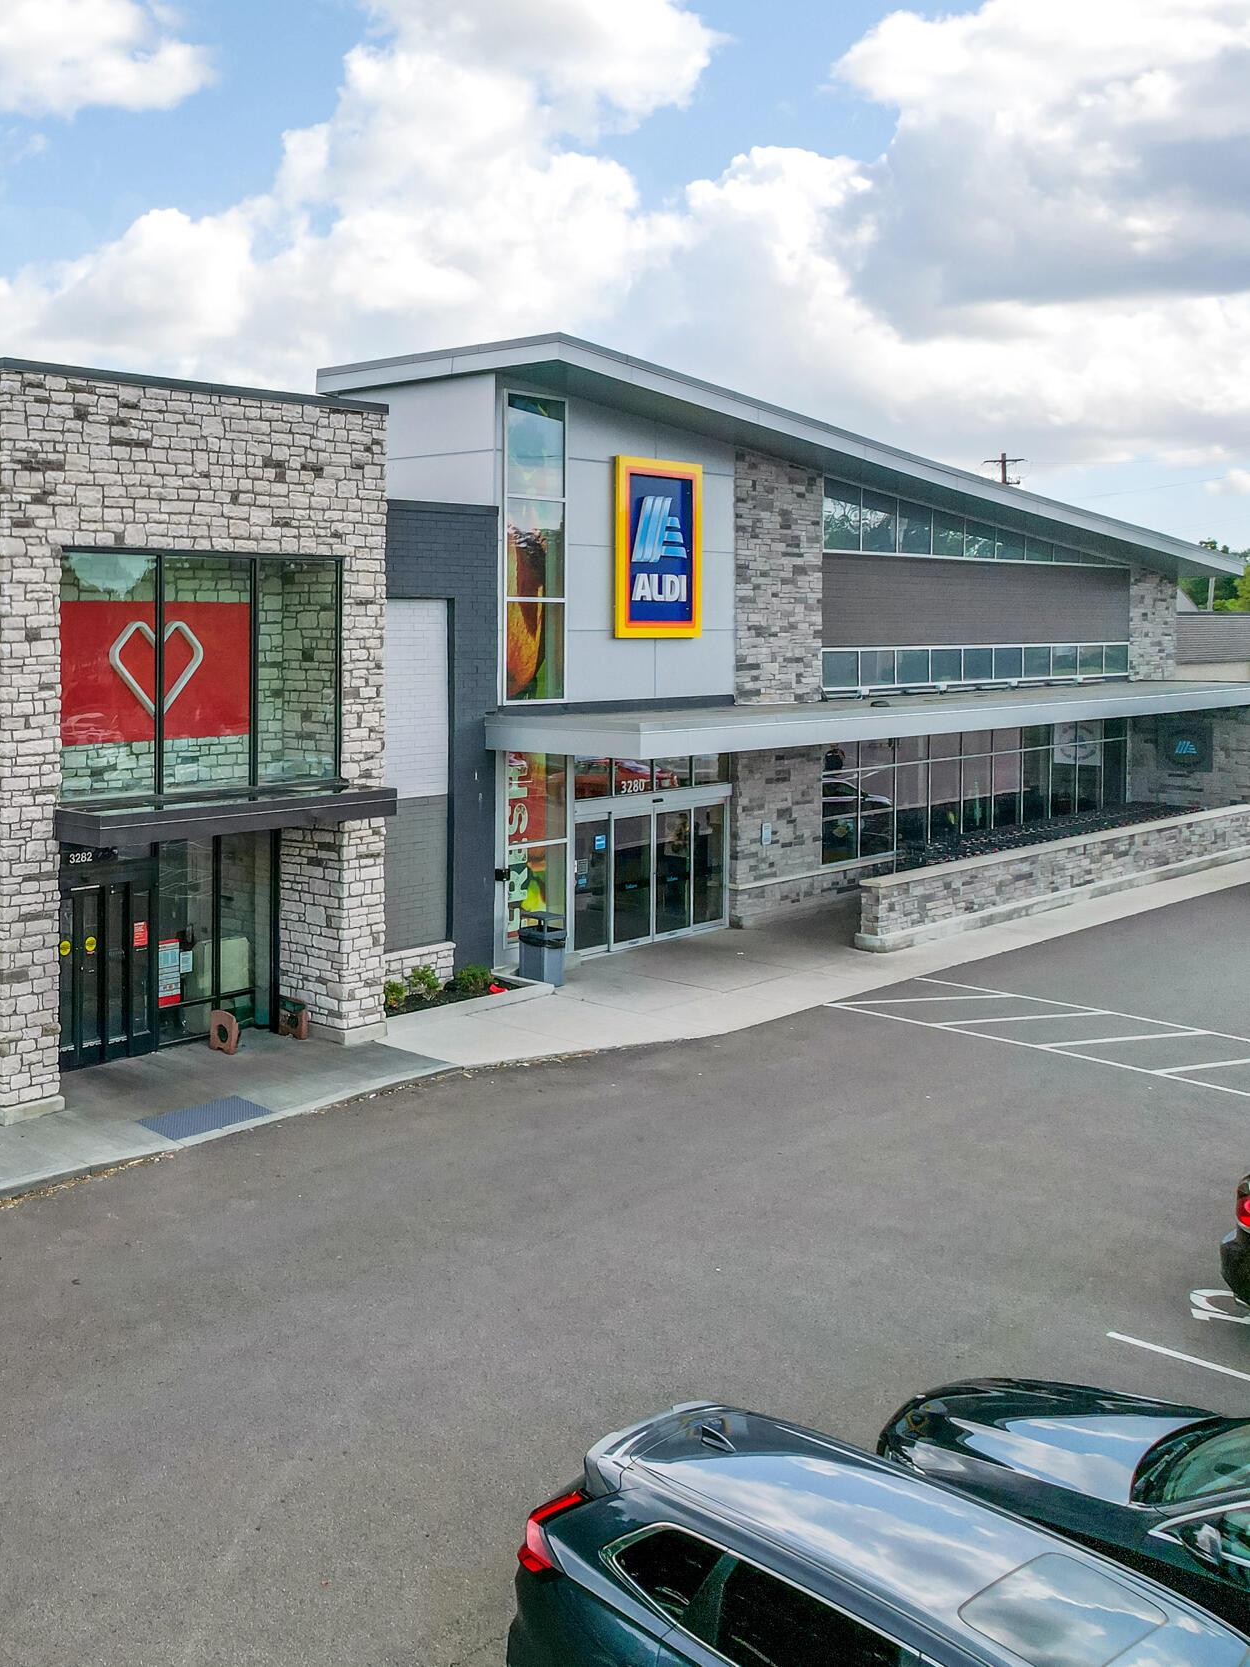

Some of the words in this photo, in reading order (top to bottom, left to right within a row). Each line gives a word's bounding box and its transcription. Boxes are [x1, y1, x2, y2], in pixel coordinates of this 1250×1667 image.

[632, 573, 687, 602] ALDI
[620, 779, 645, 794] 3280
[69, 851, 93, 864] 3282
